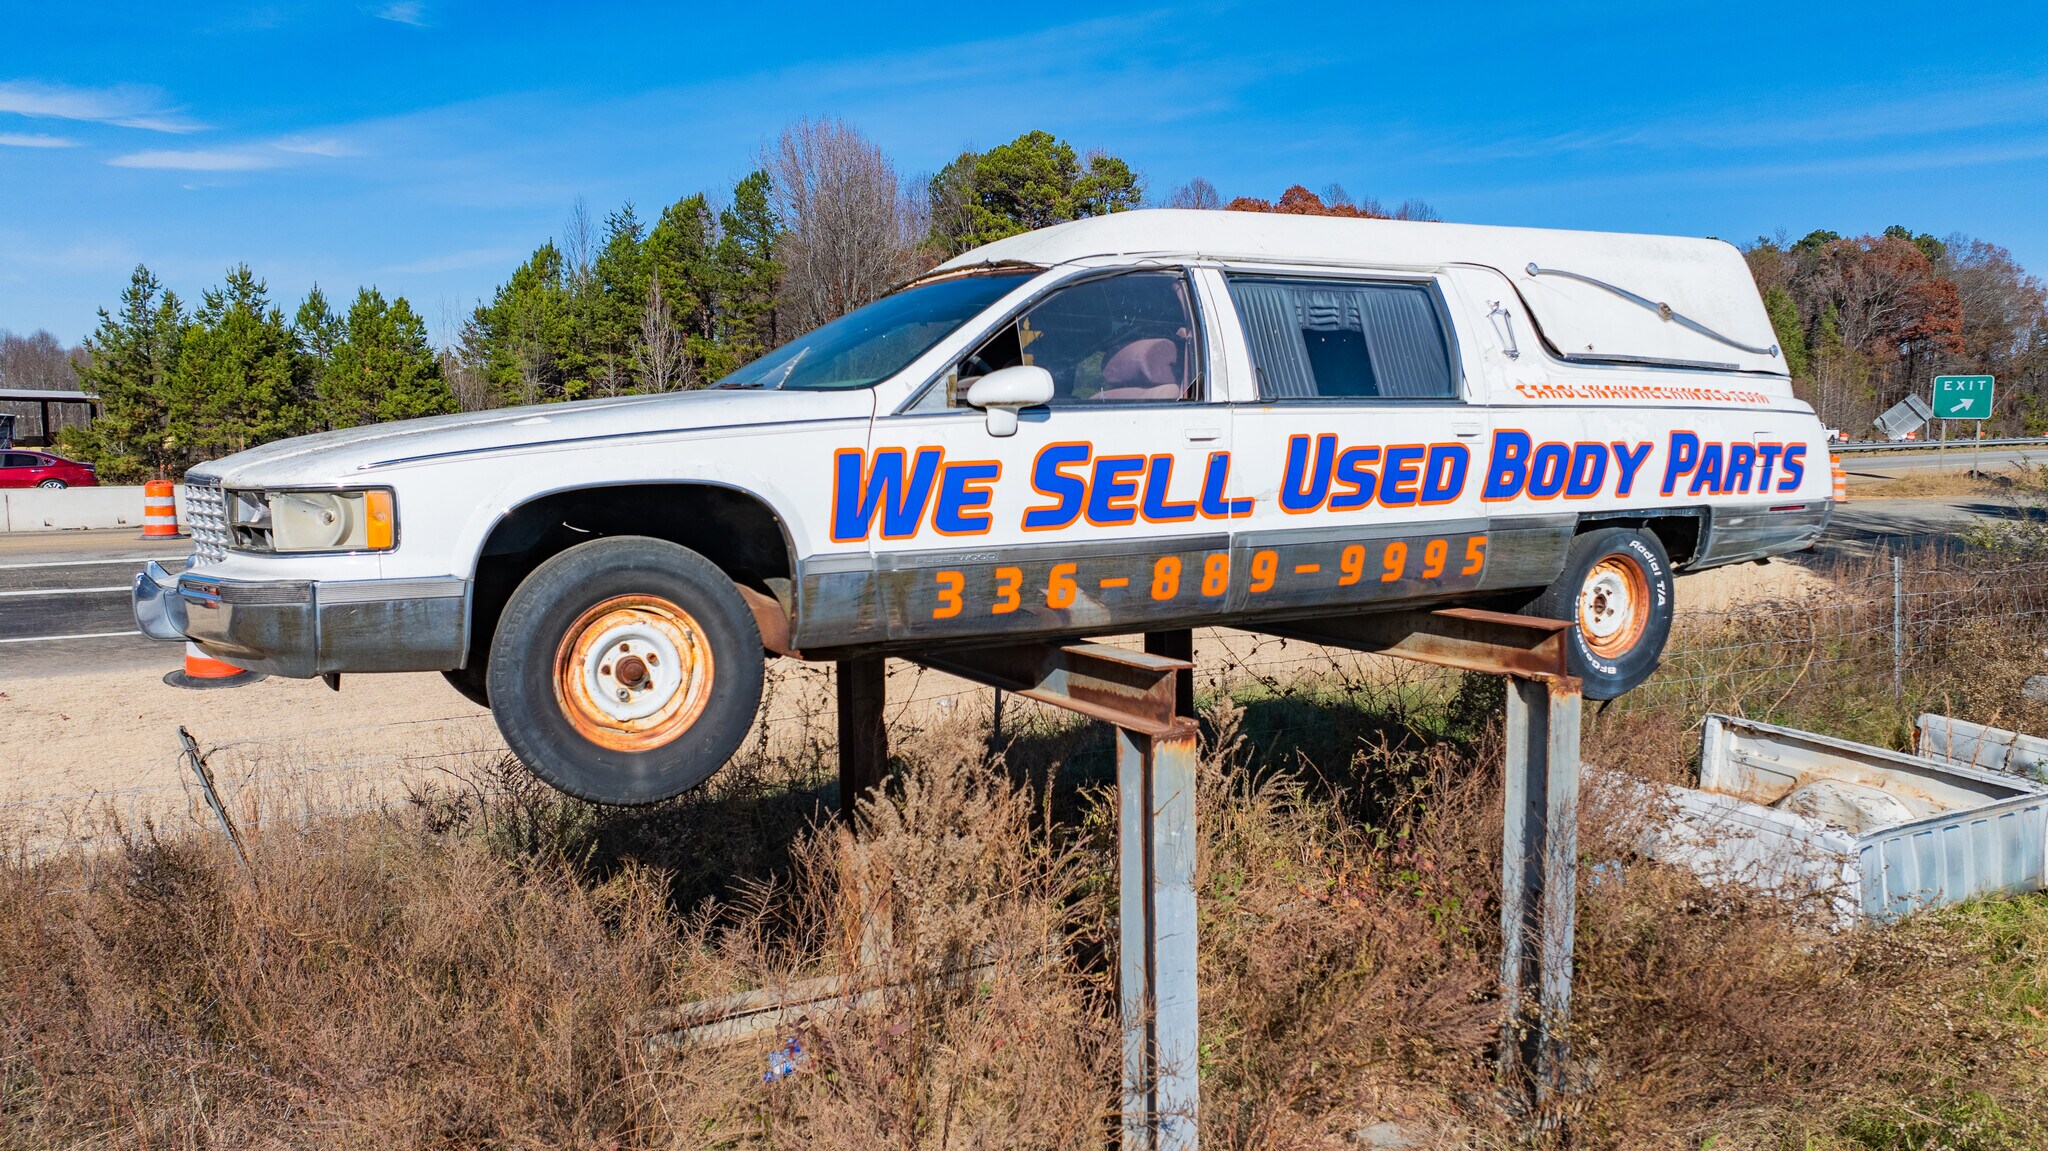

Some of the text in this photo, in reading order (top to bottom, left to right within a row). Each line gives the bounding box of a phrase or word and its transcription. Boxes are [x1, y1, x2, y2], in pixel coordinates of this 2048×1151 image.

[1943, 380, 1987, 391] EXIT
[932, 536, 1488, 620] 336-889-9995
[1629, 540, 1666, 606] Radial T/A
